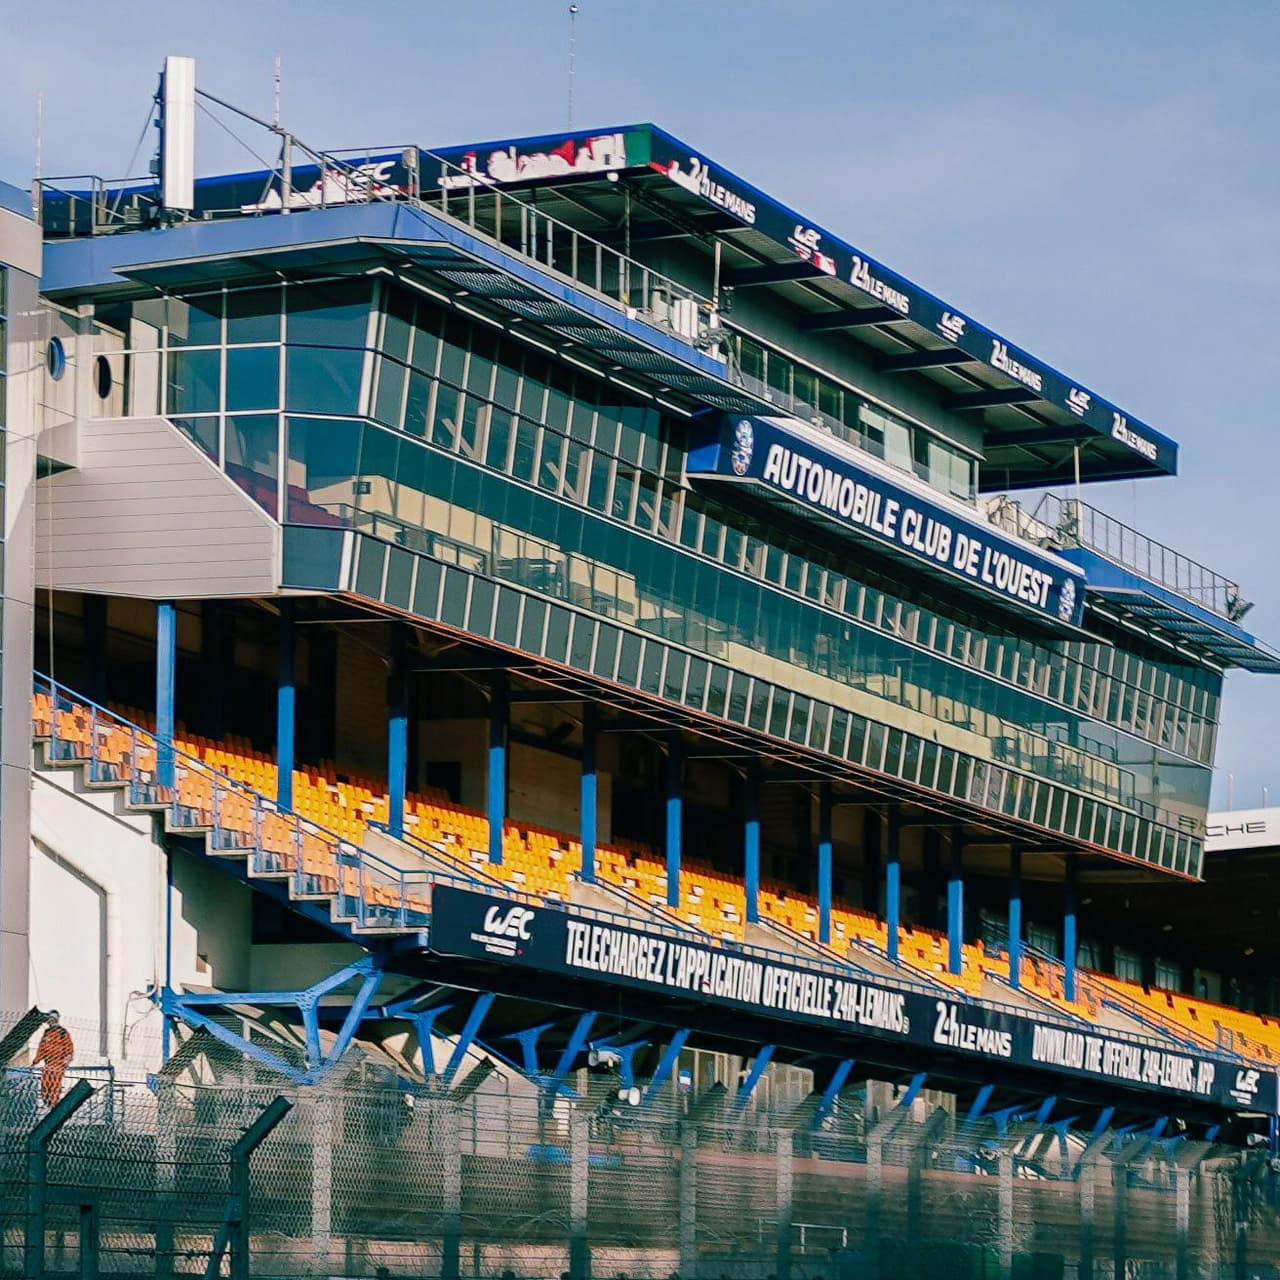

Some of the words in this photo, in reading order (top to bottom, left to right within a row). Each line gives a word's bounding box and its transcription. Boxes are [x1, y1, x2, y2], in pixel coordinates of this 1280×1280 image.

[724, 190, 756, 224] MANS
[882, 285, 910, 314] MANS
[1018, 367, 1043, 391] MANS
[763, 444, 901, 539] AUTOMOBILE
[900, 512, 952, 564] CLUB
[953, 533, 983, 575] DE
[981, 548, 1053, 609] L'OUEST
[484, 905, 535, 941] WEC
[565, 920, 666, 984] TELECHARGEZ
[666, 943, 762, 1003] L'APPLICATION
[762, 964, 832, 1017] OFFICIELLE
[933, 1001, 961, 1048] 24h
[960, 1023, 977, 1050] LE
[976, 1028, 1012, 1058] MANS
[1032, 1024, 1084, 1069] DOWNLOAD
[1085, 1035, 1103, 1073] THE
[1103, 1041, 1142, 1082] OFFICIAL
[1197, 1060, 1215, 1095] APP
